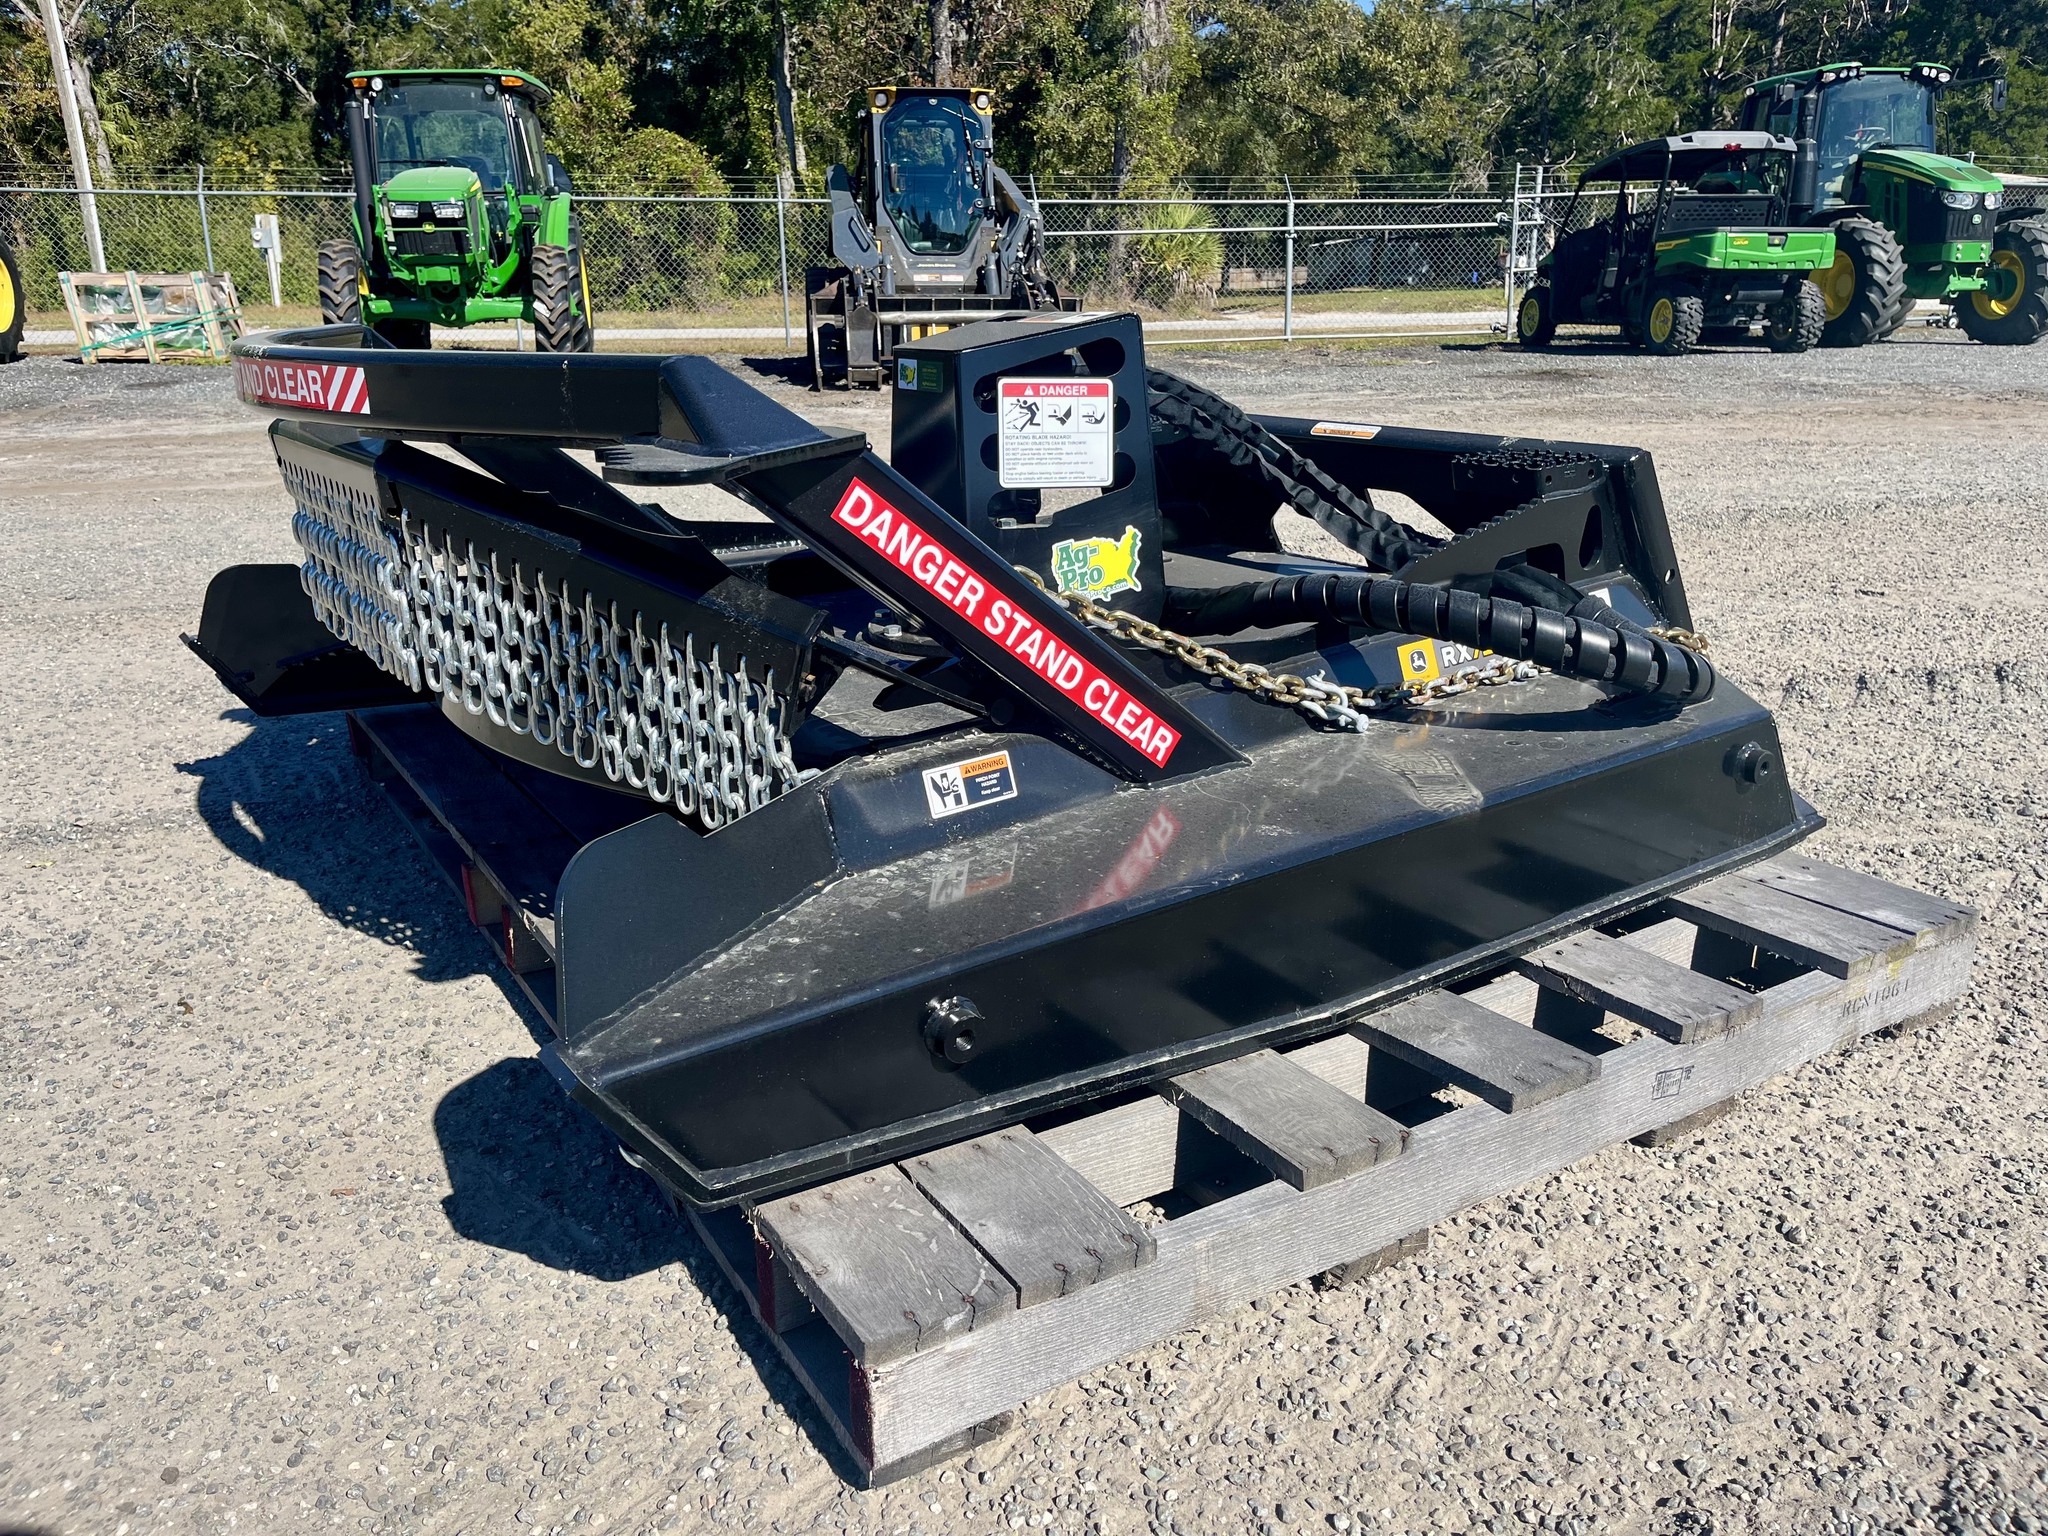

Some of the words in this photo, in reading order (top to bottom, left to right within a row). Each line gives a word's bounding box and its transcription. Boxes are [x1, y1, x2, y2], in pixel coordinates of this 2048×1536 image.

[233, 361, 264, 396] TAND
[264, 365, 325, 405] CLEAR
[1040, 385, 1088, 396] DANGER
[1057, 543, 1099, 571] Ag-
[1060, 566, 1104, 591] Pro
[838, 485, 985, 617] DANGER
[983, 600, 1084, 691] STAND
[1084, 679, 1174, 761] CLEAR
[1440, 642, 1494, 668] RX
[970, 758, 1004, 772] WARNING
